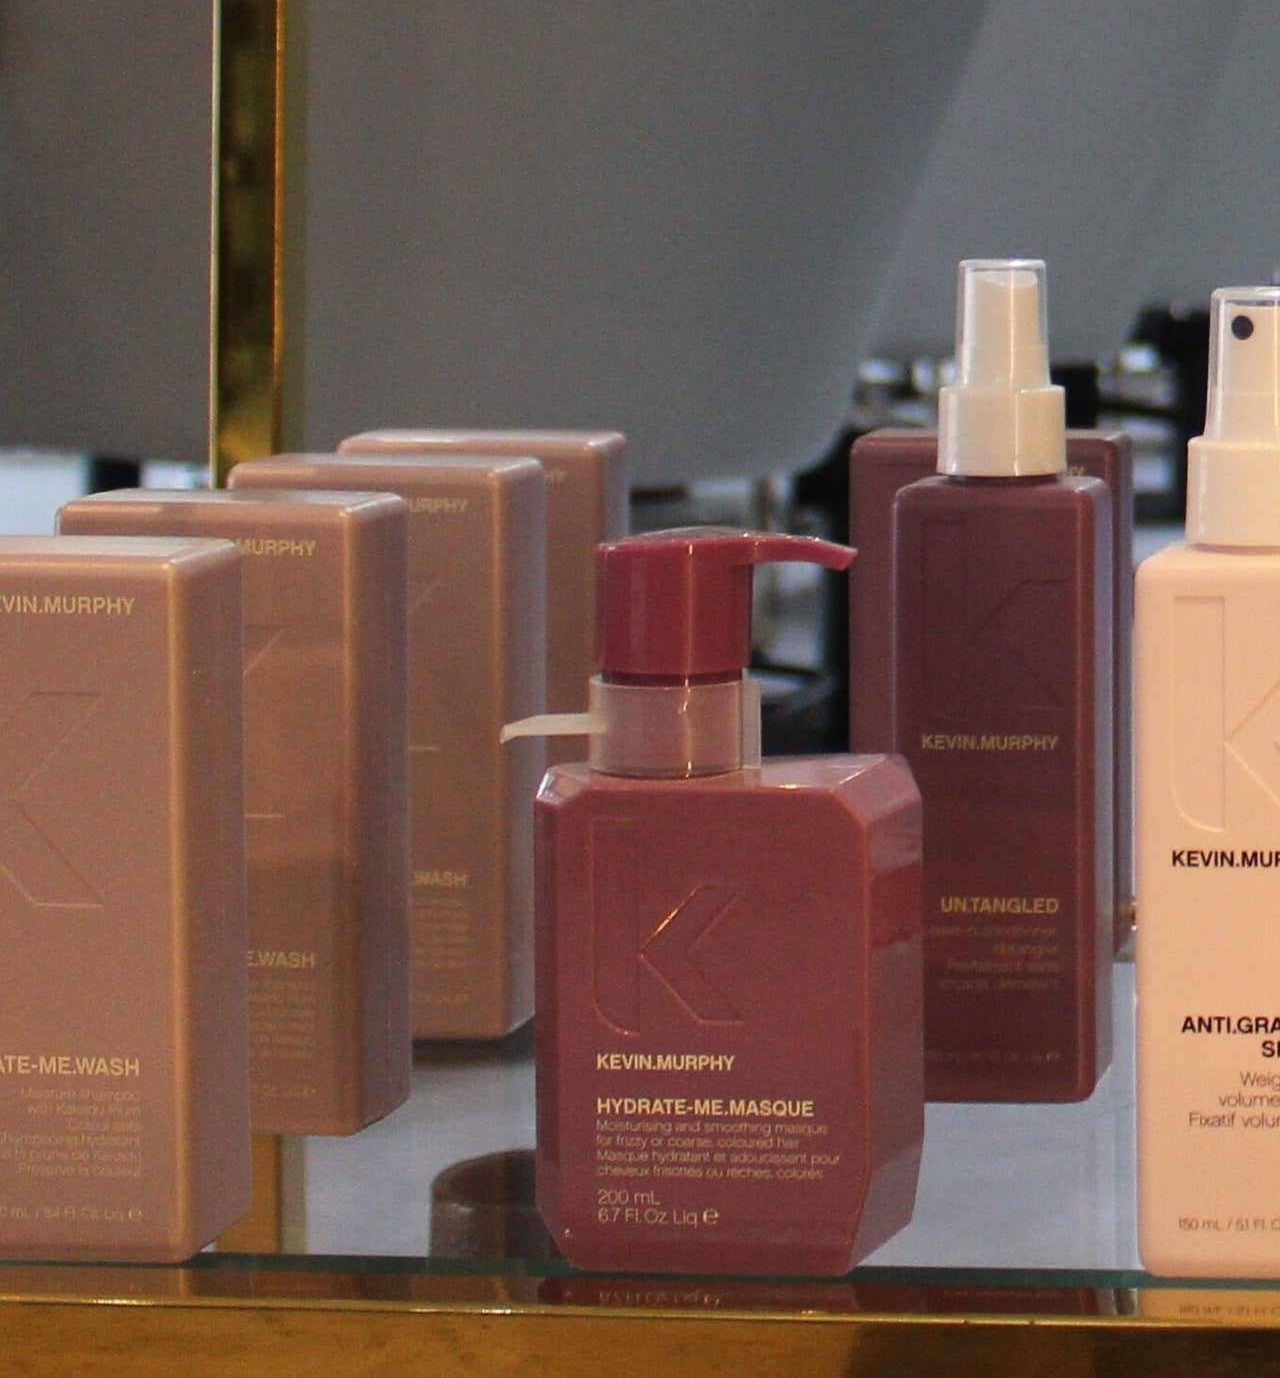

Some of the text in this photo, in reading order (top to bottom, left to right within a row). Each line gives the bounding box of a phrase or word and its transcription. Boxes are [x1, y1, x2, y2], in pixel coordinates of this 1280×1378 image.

[0, 595, 135, 614] VIN.MURPHY
[922, 734, 1059, 750] KEVIN.MURPHY
[941, 897, 1059, 913] UN.TANGLED
[597, 1054, 735, 1071] KEVIN.MURPHY
[597, 1098, 814, 1117] HYDRATE-ME.MASQUE
[1218, 1091, 1280, 1108] volume
[1188, 1112, 1236, 1128] Fixatif
[675, 1121, 700, 1132] and
[704, 1121, 771, 1137] smoothing
[775, 1123, 828, 1136] masque
[616, 1135, 647, 1150] frizzy
[651, 1137, 664, 1147] or
[717, 1136, 773, 1149] coloured
[597, 1150, 648, 1164] Masque
[652, 1149, 709, 1166] hydratant
[811, 1152, 840, 1167] pour
[598, 1189, 660, 1205] 200 mL
[598, 1207, 620, 1223] 6.7
